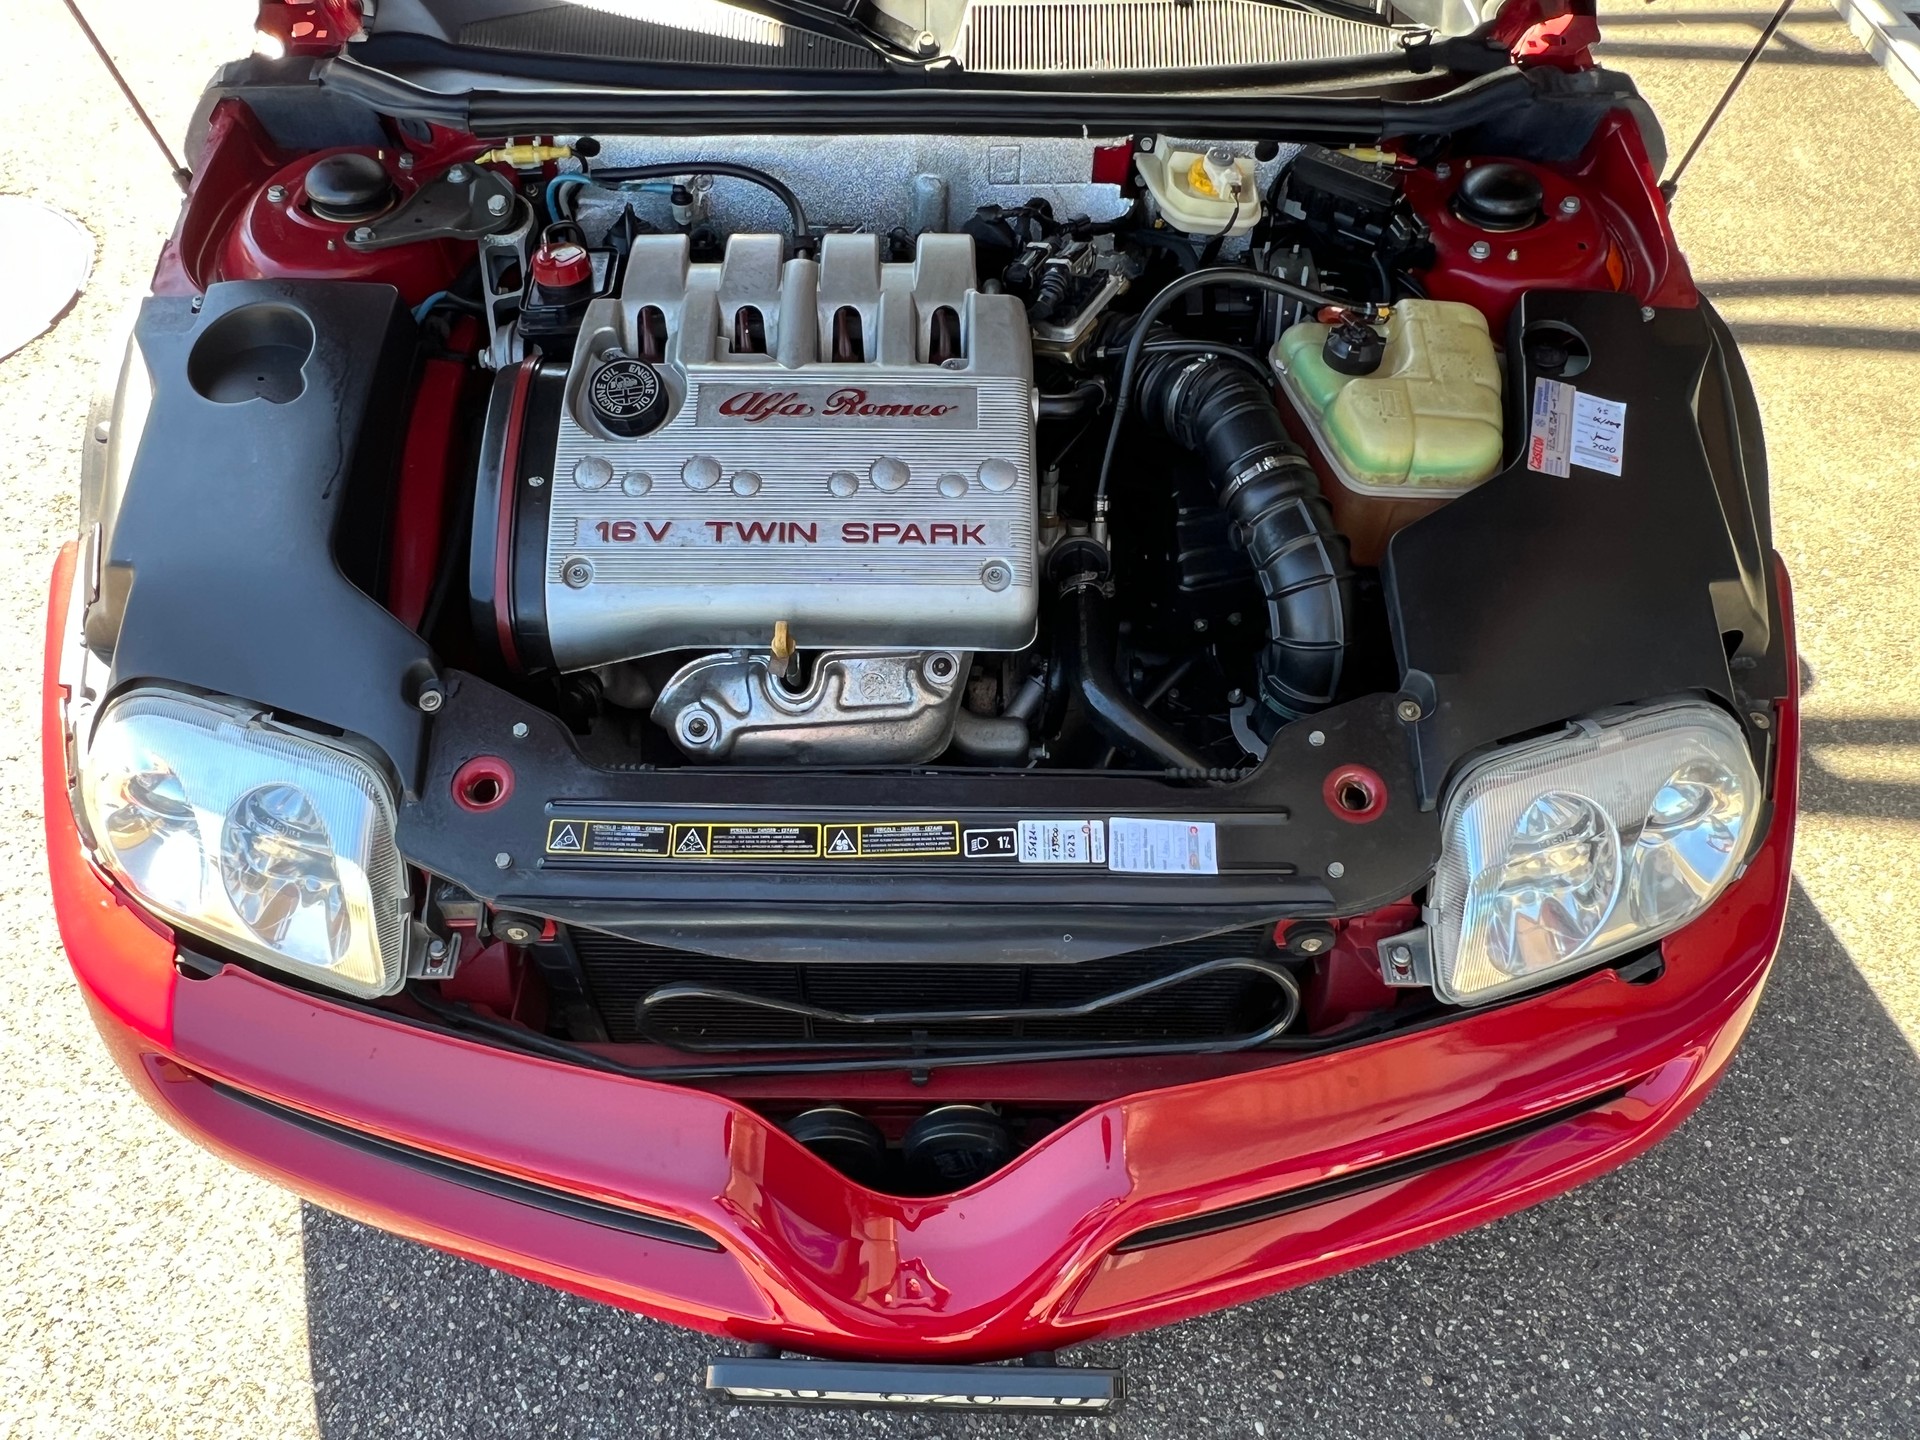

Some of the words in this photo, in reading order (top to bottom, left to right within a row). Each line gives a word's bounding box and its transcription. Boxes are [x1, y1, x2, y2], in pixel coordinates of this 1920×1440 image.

[601, 368, 619, 383] OIL
[628, 364, 655, 395] ENGINE
[597, 383, 623, 414] ENGINE
[633, 396, 651, 411] OIL
[718, 391, 815, 424] Alfa
[821, 387, 959, 417] Romeo
[704, 521, 818, 544] TWIN
[841, 523, 987, 546] SPARK
[997, 836, 1011, 849] 1%
